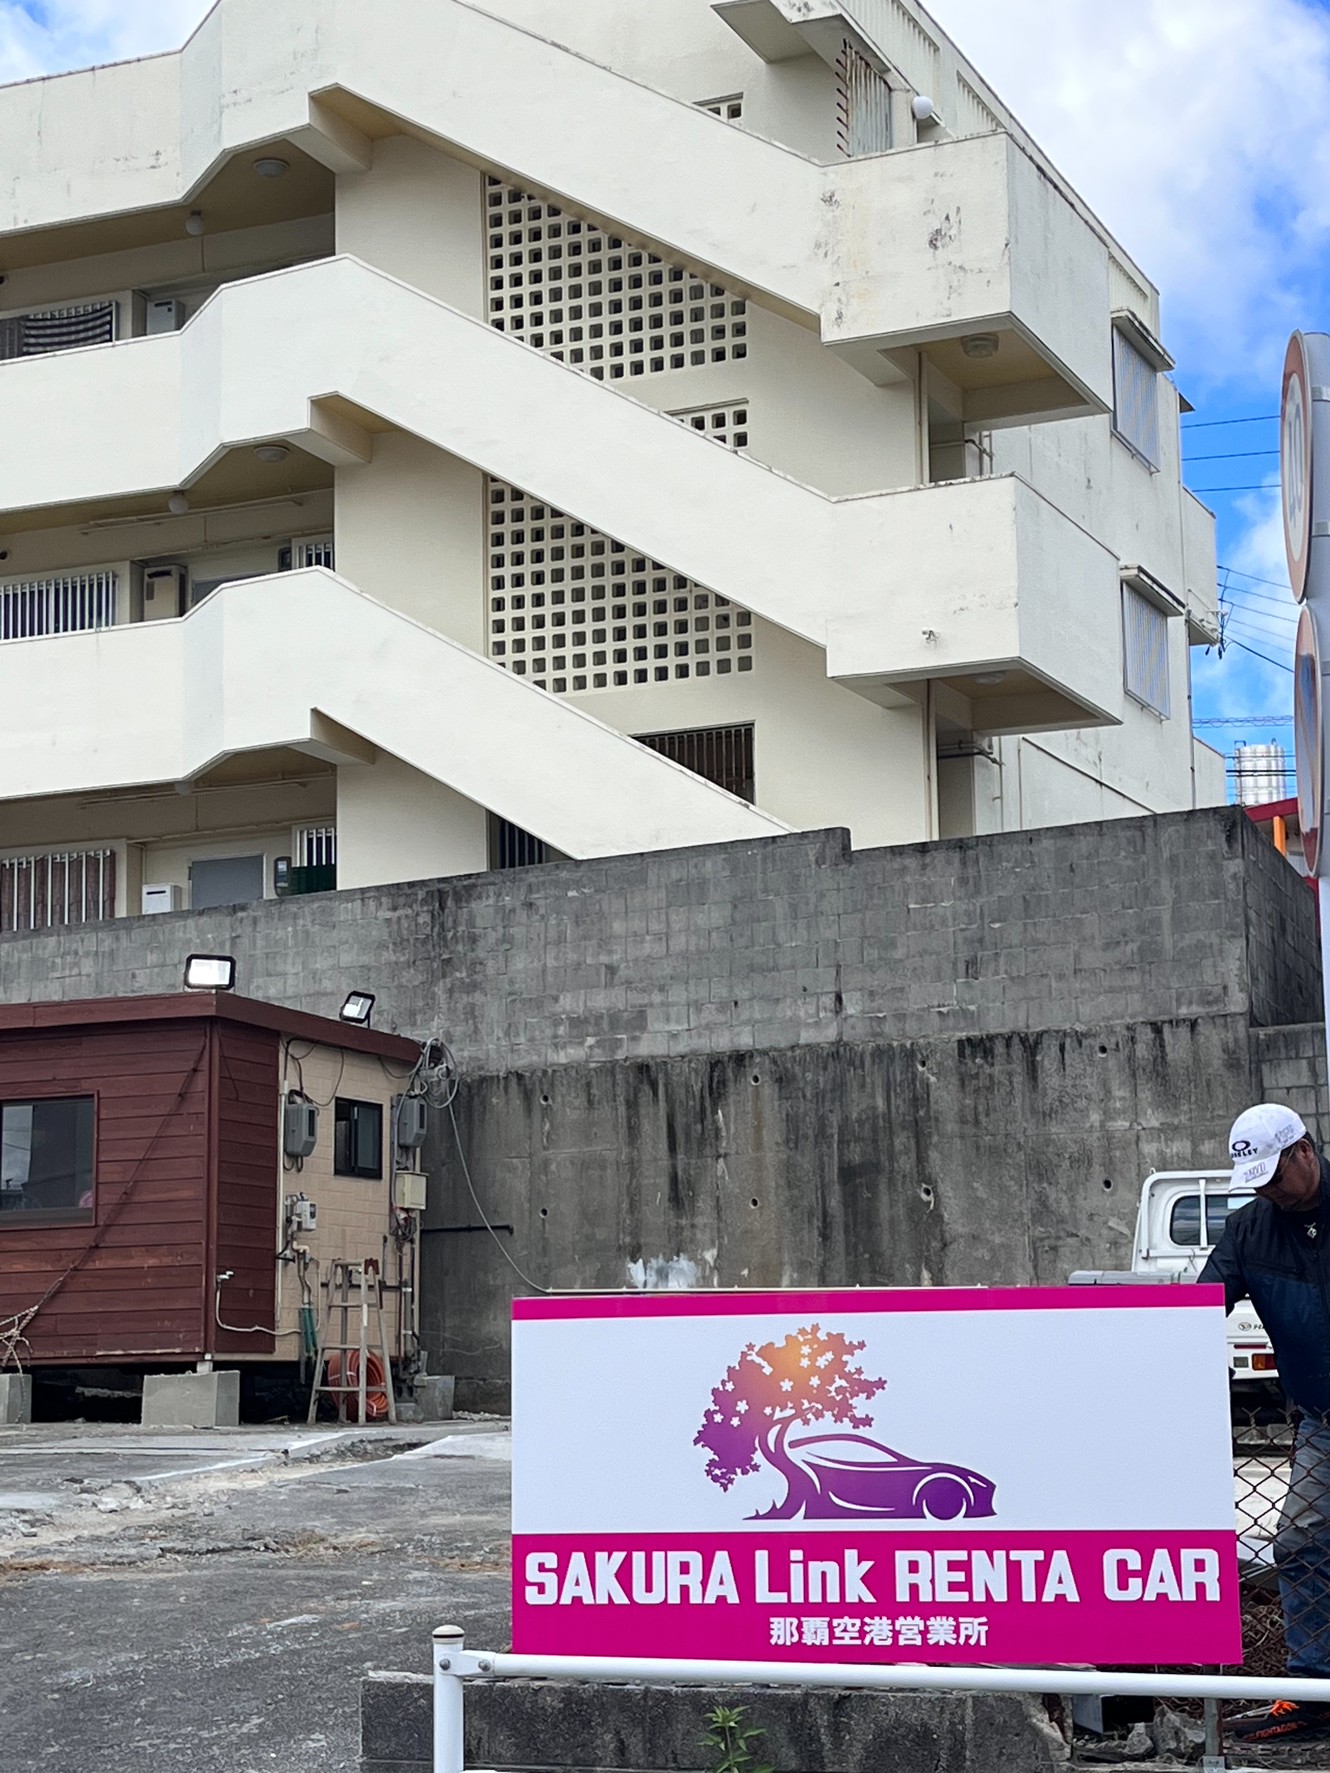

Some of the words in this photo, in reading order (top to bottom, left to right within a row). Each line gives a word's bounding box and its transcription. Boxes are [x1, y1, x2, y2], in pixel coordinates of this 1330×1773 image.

[525, 1551, 739, 1605] SAKURA
[755, 1549, 876, 1604] Link
[895, 1550, 1080, 1603] RENTA
[1103, 1549, 1221, 1602] CAR
[769, 1615, 988, 1646] 那覇空港営業所
